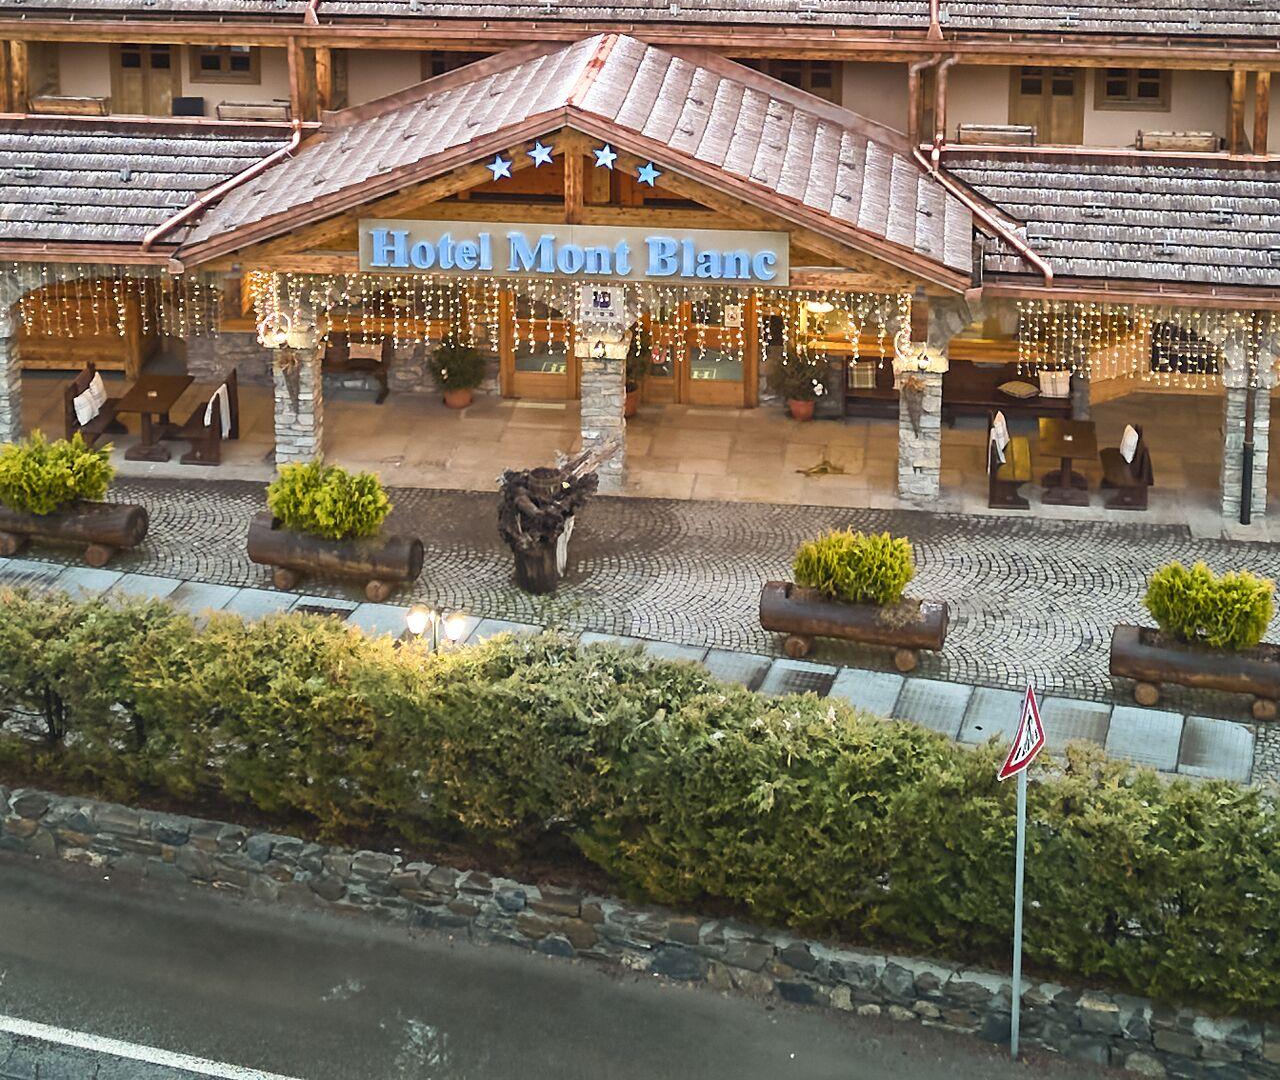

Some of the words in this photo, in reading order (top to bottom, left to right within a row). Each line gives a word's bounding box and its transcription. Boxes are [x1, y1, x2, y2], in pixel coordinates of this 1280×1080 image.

[369, 228, 494, 271] Hotel
[506, 231, 633, 276] Mont
[644, 235, 778, 282] Blanc
